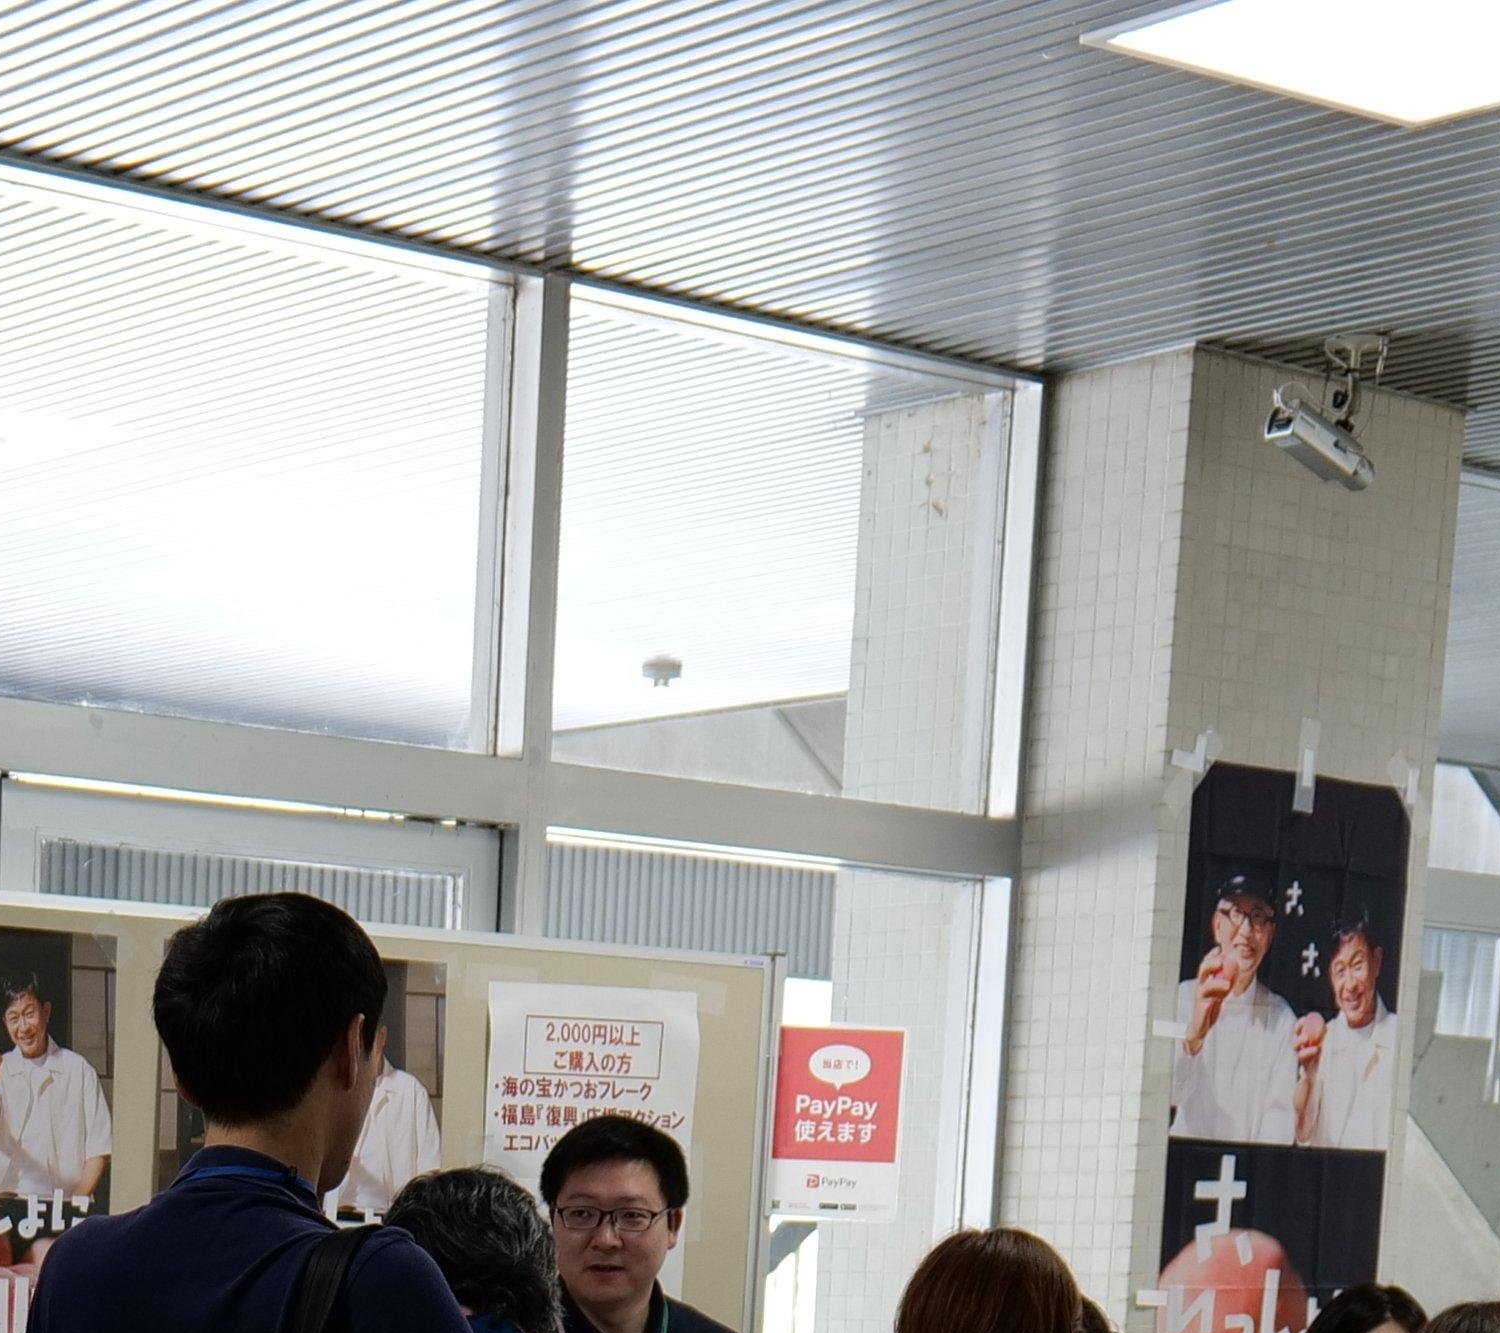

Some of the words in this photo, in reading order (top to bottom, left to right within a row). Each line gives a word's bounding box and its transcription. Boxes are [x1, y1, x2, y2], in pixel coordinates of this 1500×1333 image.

[545, 1022, 642, 1047] 2,000円以上
[553, 1050, 633, 1074] ご購入の方
[822, 1058, 860, 1070] 当店で!
[794, 1095, 878, 1120] PayPay
[794, 1120, 877, 1143] 使えます
[821, 1176, 858, 1189] PayPay
